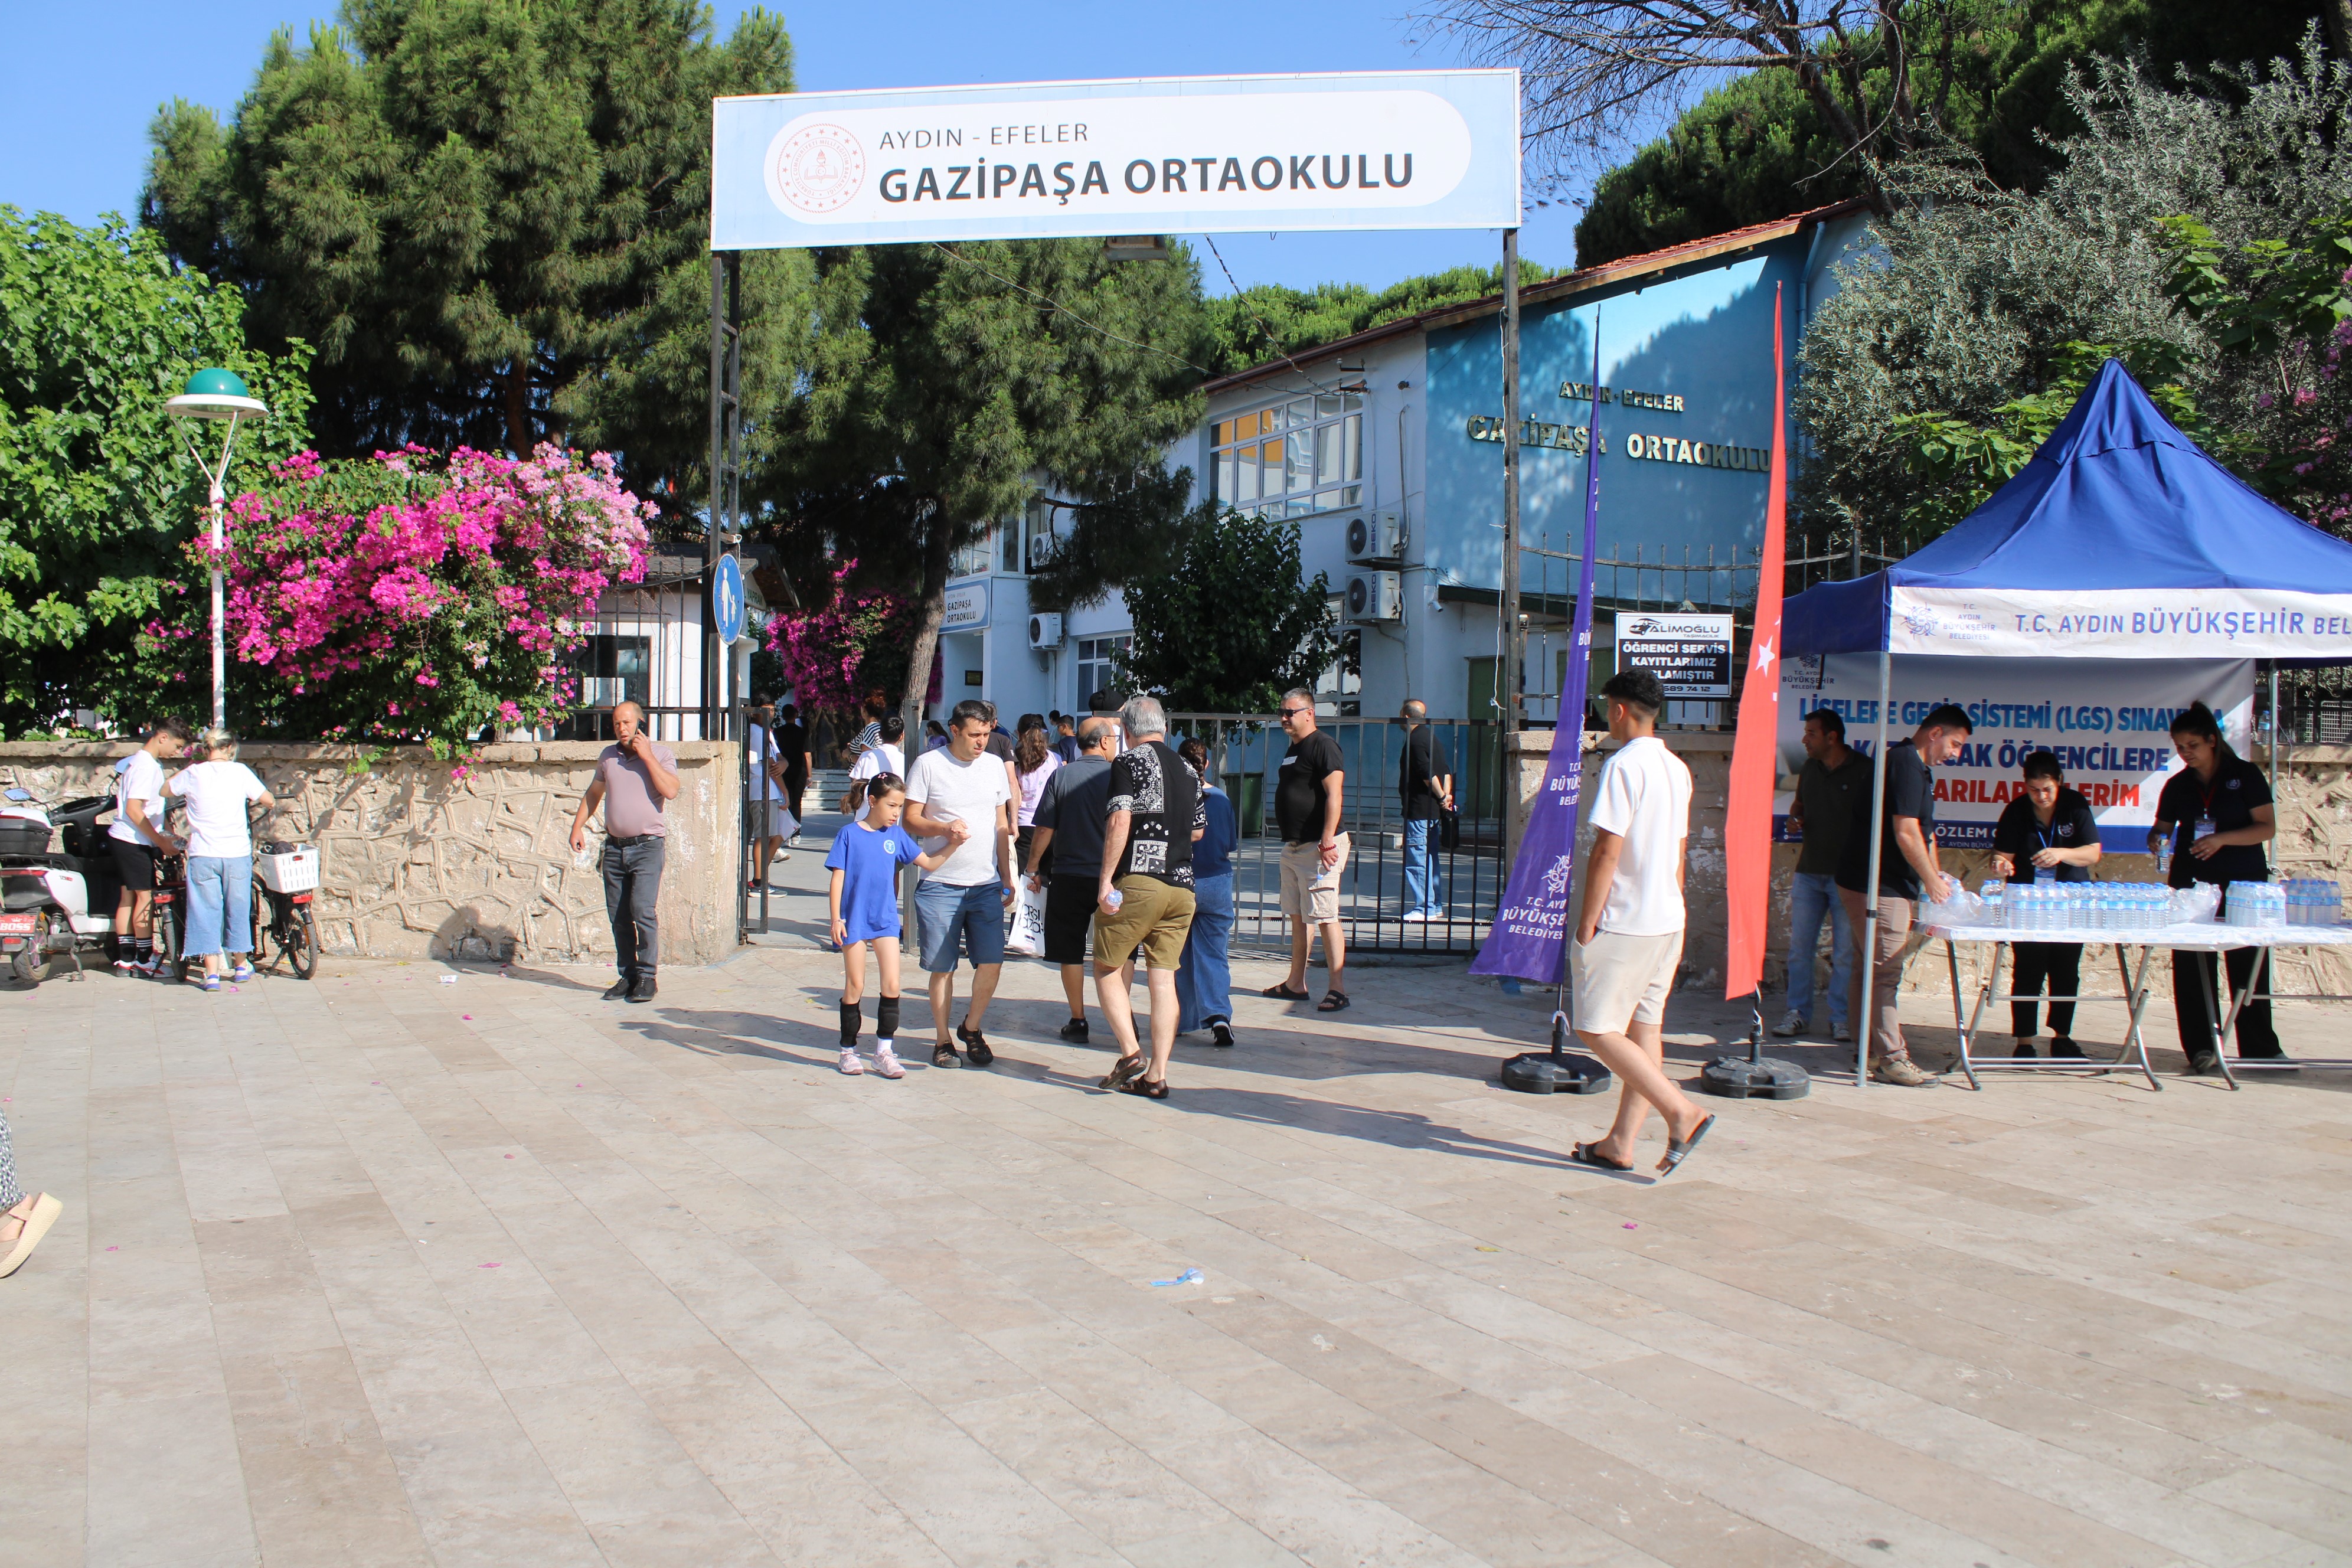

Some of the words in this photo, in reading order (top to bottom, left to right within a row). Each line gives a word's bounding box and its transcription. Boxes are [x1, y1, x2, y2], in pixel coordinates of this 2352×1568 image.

[879, 129, 962, 150] AYDIN
[991, 123, 1088, 145] EFELER
[879, 157, 1110, 205] GAZİPAŞA
[1124, 153, 1413, 194] ORTAOKULU
[1560, 381, 1612, 403] AYDN
[1622, 390, 1684, 413] EFELER
[1626, 433, 1771, 472] ORTAOKULU
[947, 599, 971, 610] GAZİPAŞA
[947, 610, 976, 623] ORTAOKULU
[1649, 623, 1720, 633] ALİMOĞLU
[1943, 622, 1996, 632] BÜYÜKŞEHİR
[2014, 614, 2051, 632] T.C.
[2059, 615, 2124, 633] AYDIN
[2131, 607, 2304, 641] BÜYÜKŞEHİR
[1622, 641, 1678, 654] ÖĞRENCİ
[1681, 642, 1726, 654] SERVİS
[1631, 656, 1717, 667] KAYITLARIMIZ
[1651, 669, 1714, 682] LAMIŞTIR
[1966, 698, 2052, 729] SİSTEMİ
[2056, 705, 2113, 734] (LGS)
[2117, 707, 2225, 732] SINAVA
[1935, 823, 1988, 838] ÖZLEM
[1526, 897, 1544, 907] T.C.
[0, 922, 31, 931] BOSS
